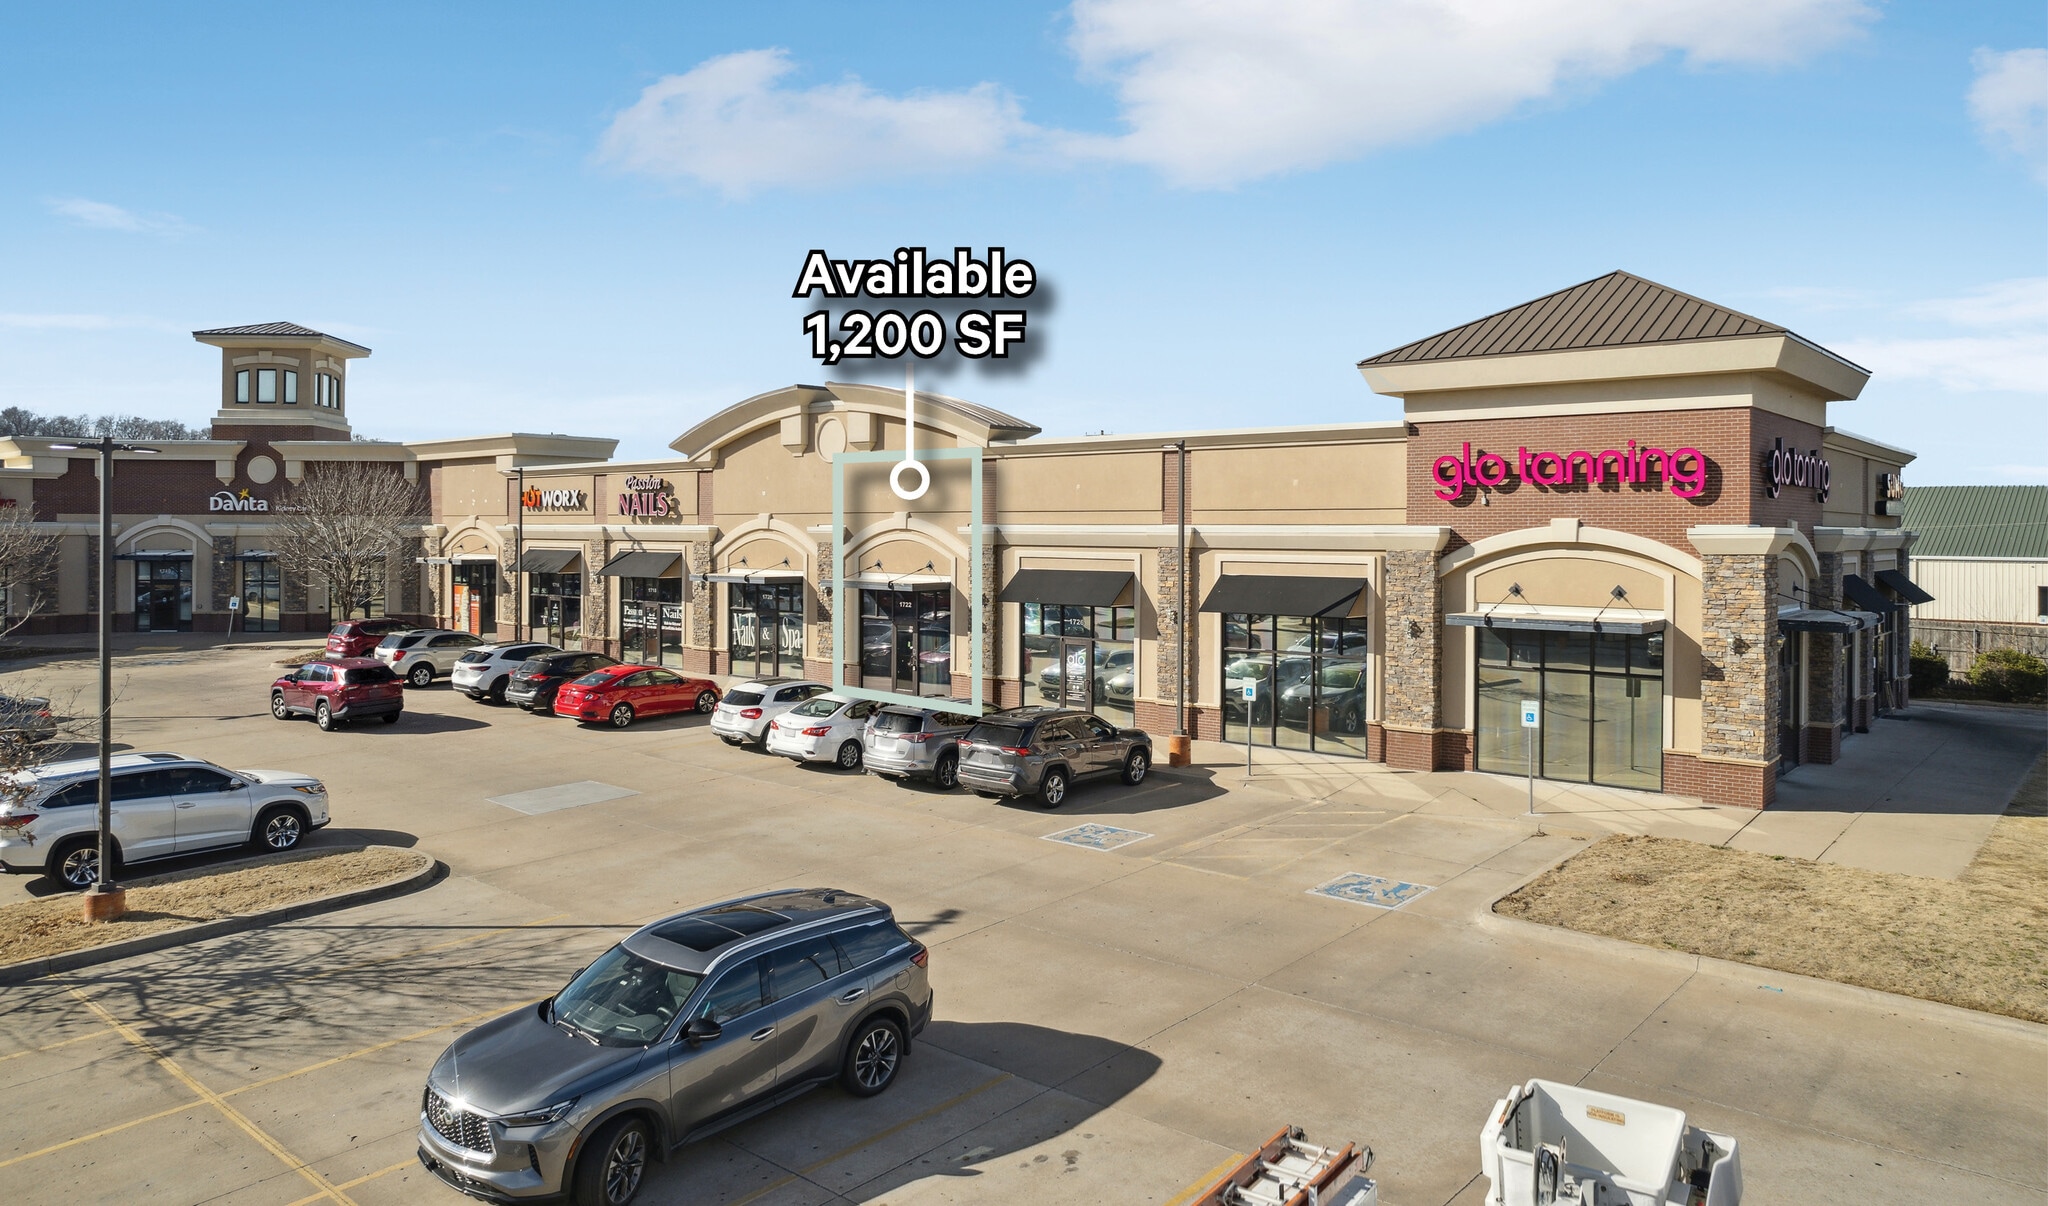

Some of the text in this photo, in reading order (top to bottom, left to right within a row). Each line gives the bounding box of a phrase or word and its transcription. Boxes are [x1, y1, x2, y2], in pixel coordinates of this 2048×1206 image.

[625, 475, 662, 491] Passion
[1432, 440, 1706, 500] glo tanning
[1772, 438, 1830, 503] glo tanning
[210, 490, 268, 511] DaVita
[618, 492, 669, 517] NAILS
[732, 613, 801, 656] Nails & Spa
